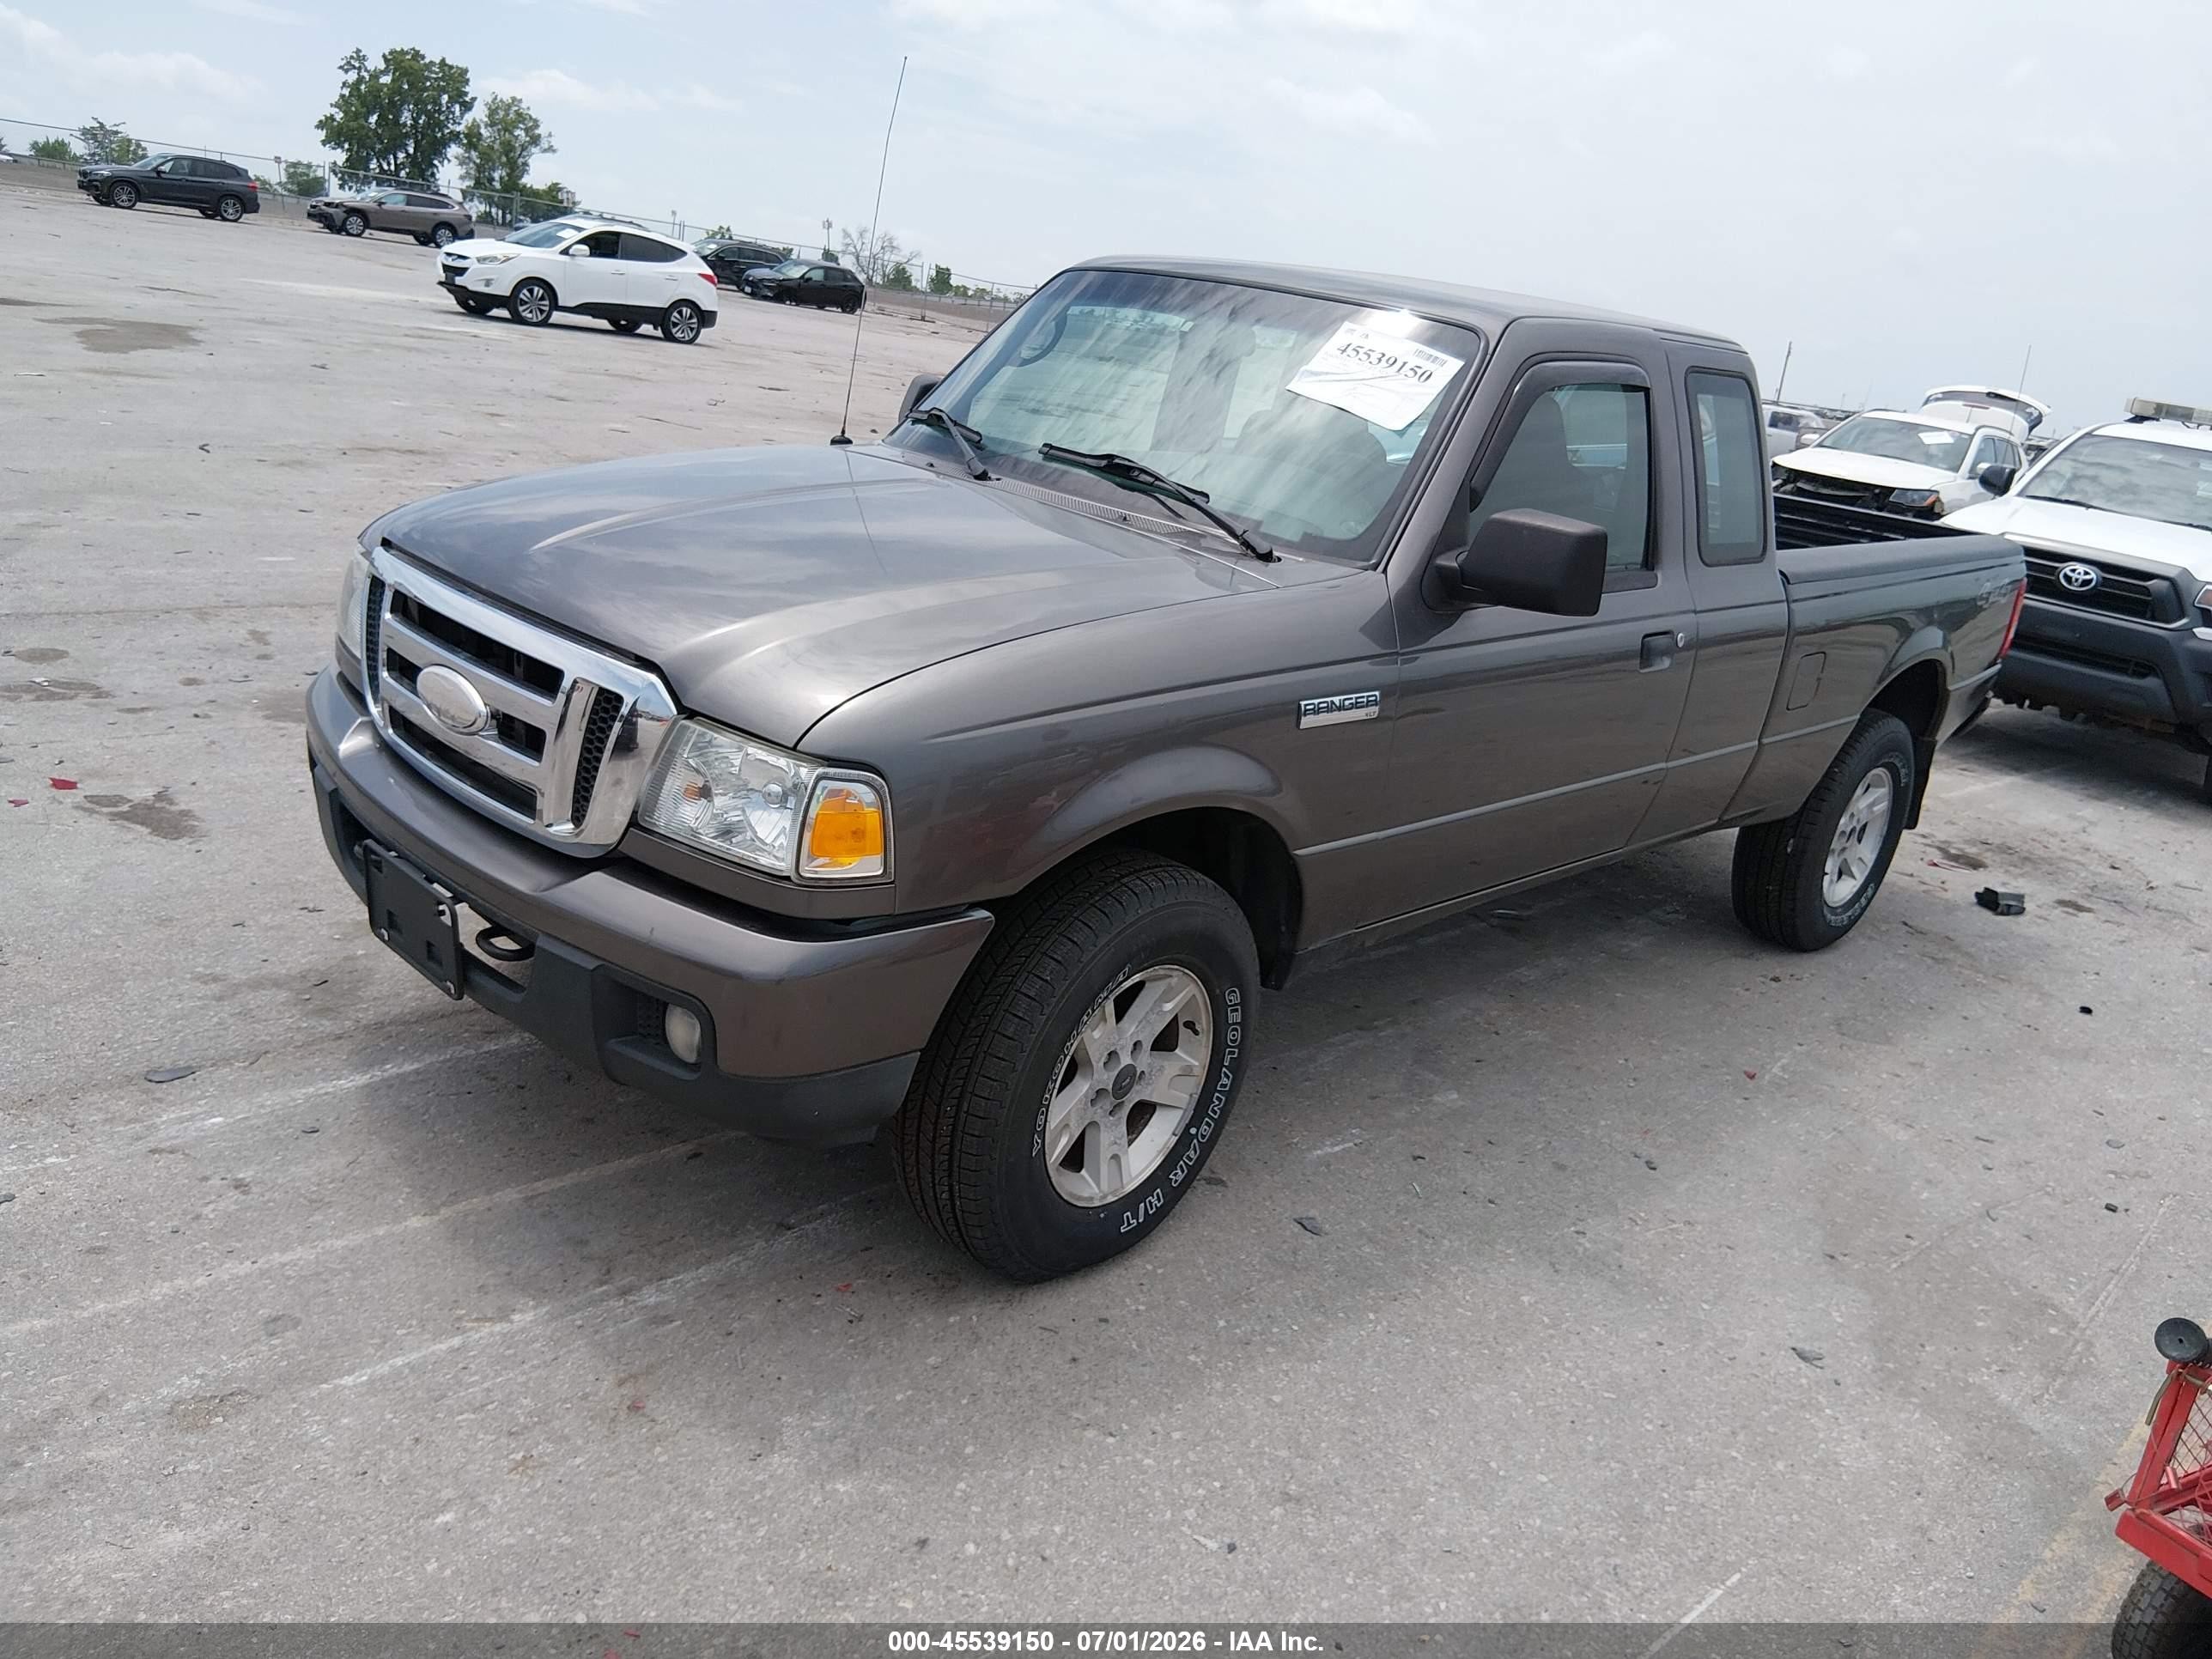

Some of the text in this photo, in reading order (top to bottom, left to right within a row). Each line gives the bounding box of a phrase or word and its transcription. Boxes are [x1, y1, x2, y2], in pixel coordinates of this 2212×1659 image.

[1336, 343, 1433, 384] 45539150
[1303, 694, 1379, 717] RANGER
[1120, 988, 1242, 1233] GEOLANDAR H/T
